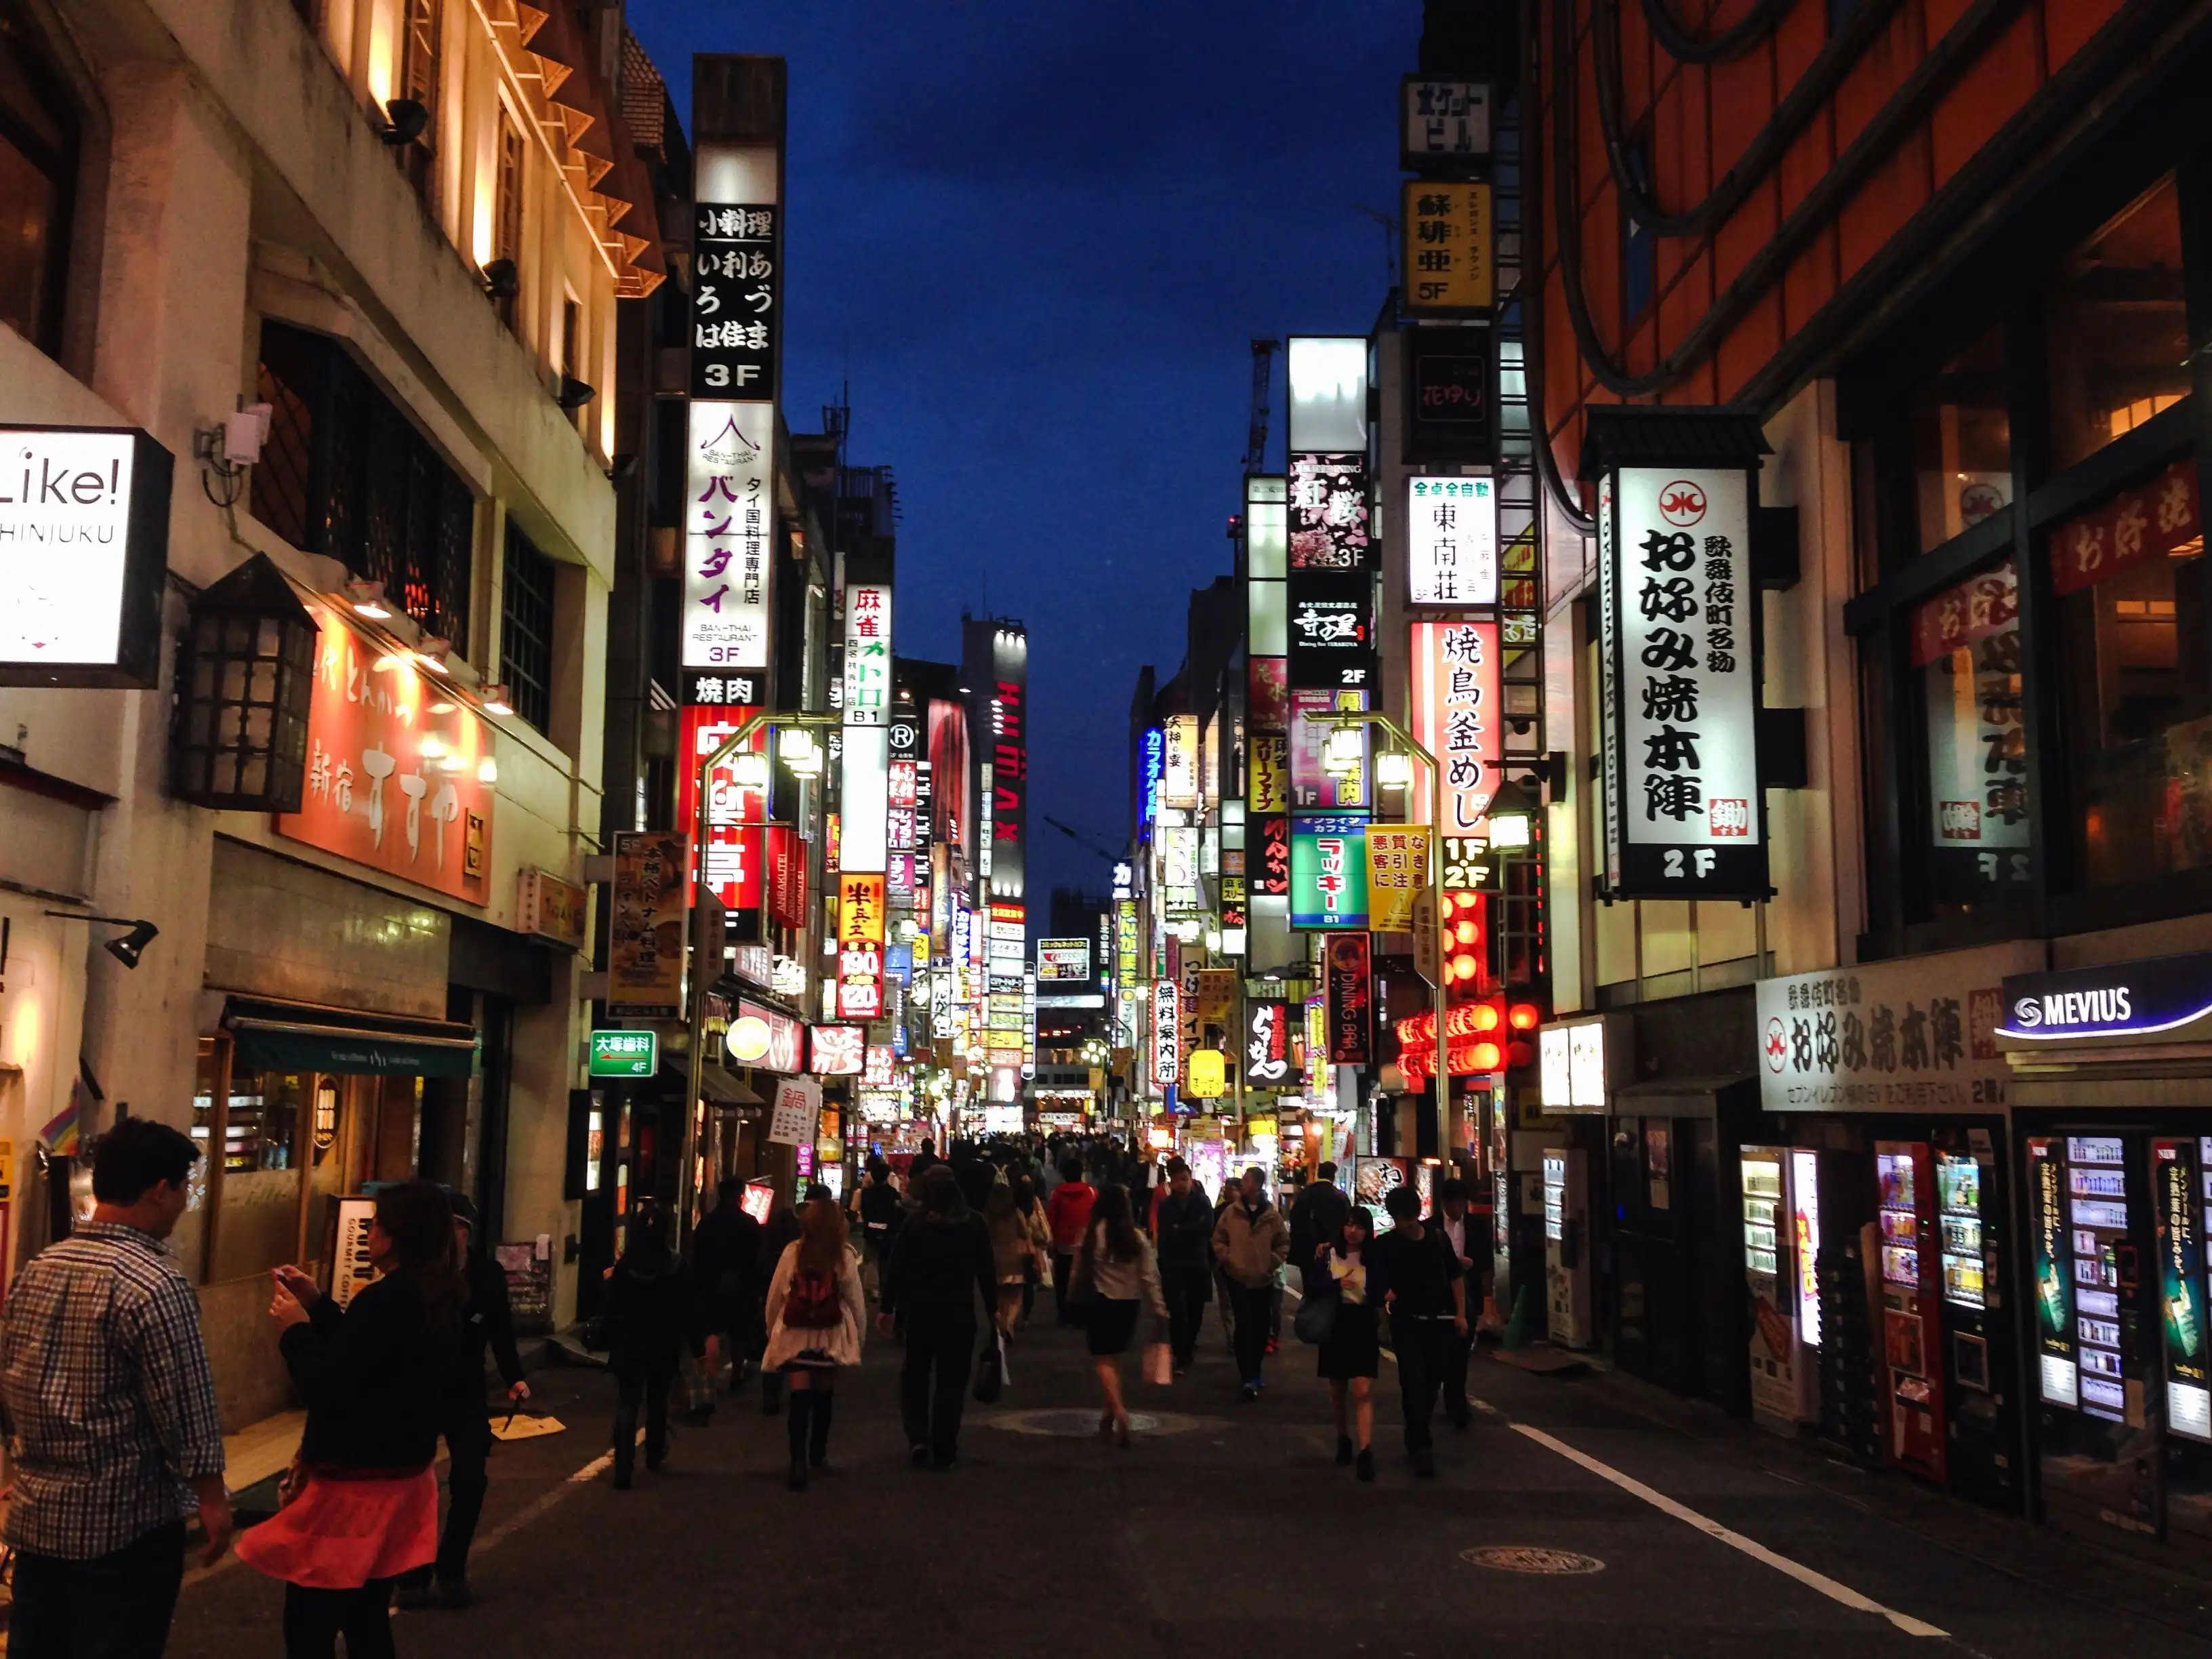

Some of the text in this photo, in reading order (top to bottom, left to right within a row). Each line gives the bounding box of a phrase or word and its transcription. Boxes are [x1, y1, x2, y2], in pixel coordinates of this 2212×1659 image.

[699, 209, 773, 239] 小料理
[1418, 282, 1448, 300] 5F
[705, 364, 761, 387] 3F
[1414, 482, 1488, 497] 全卓全自動
[697, 475, 739, 613] バンタイ
[1433, 502, 1458, 600] 東南荘
[1338, 548, 1364, 567] 3F
[855, 588, 881, 636] 麻雀
[1704, 535, 1736, 674] 歌舞伎町名物
[693, 634, 759, 642] RESTAURANT
[700, 624, 752, 632] BAN-THAI
[709, 647, 740, 662] 3F
[1342, 669, 1366, 683] 2F
[1637, 529, 1704, 823] お好み焼本陣
[695, 676, 753, 703] 焼肉
[854, 710, 878, 722] B1
[1445, 627, 1483, 828] 焼鳥釜めし
[1294, 785, 1317, 806] 1F
[1314, 824, 1349, 834] カフェ
[1371, 833, 1425, 851] 悪質な
[1372, 853, 1425, 869] 客引き
[1663, 848, 1717, 878] 2F
[1317, 838, 1346, 911] ラッキー
[1374, 872, 1425, 890] に注意
[1323, 915, 1340, 923] B1
[1340, 973, 1358, 1050] DINING BAR
[2043, 987, 2132, 1027] MEVIUS
[1157, 985, 1176, 1078] 無料案内所
[1791, 996, 1964, 1074] お好み焼本陣
[595, 1036, 650, 1052] 大塚歯科
[631, 1062, 647, 1073] 4F
[344, 1219, 357, 1274] GOURMET
